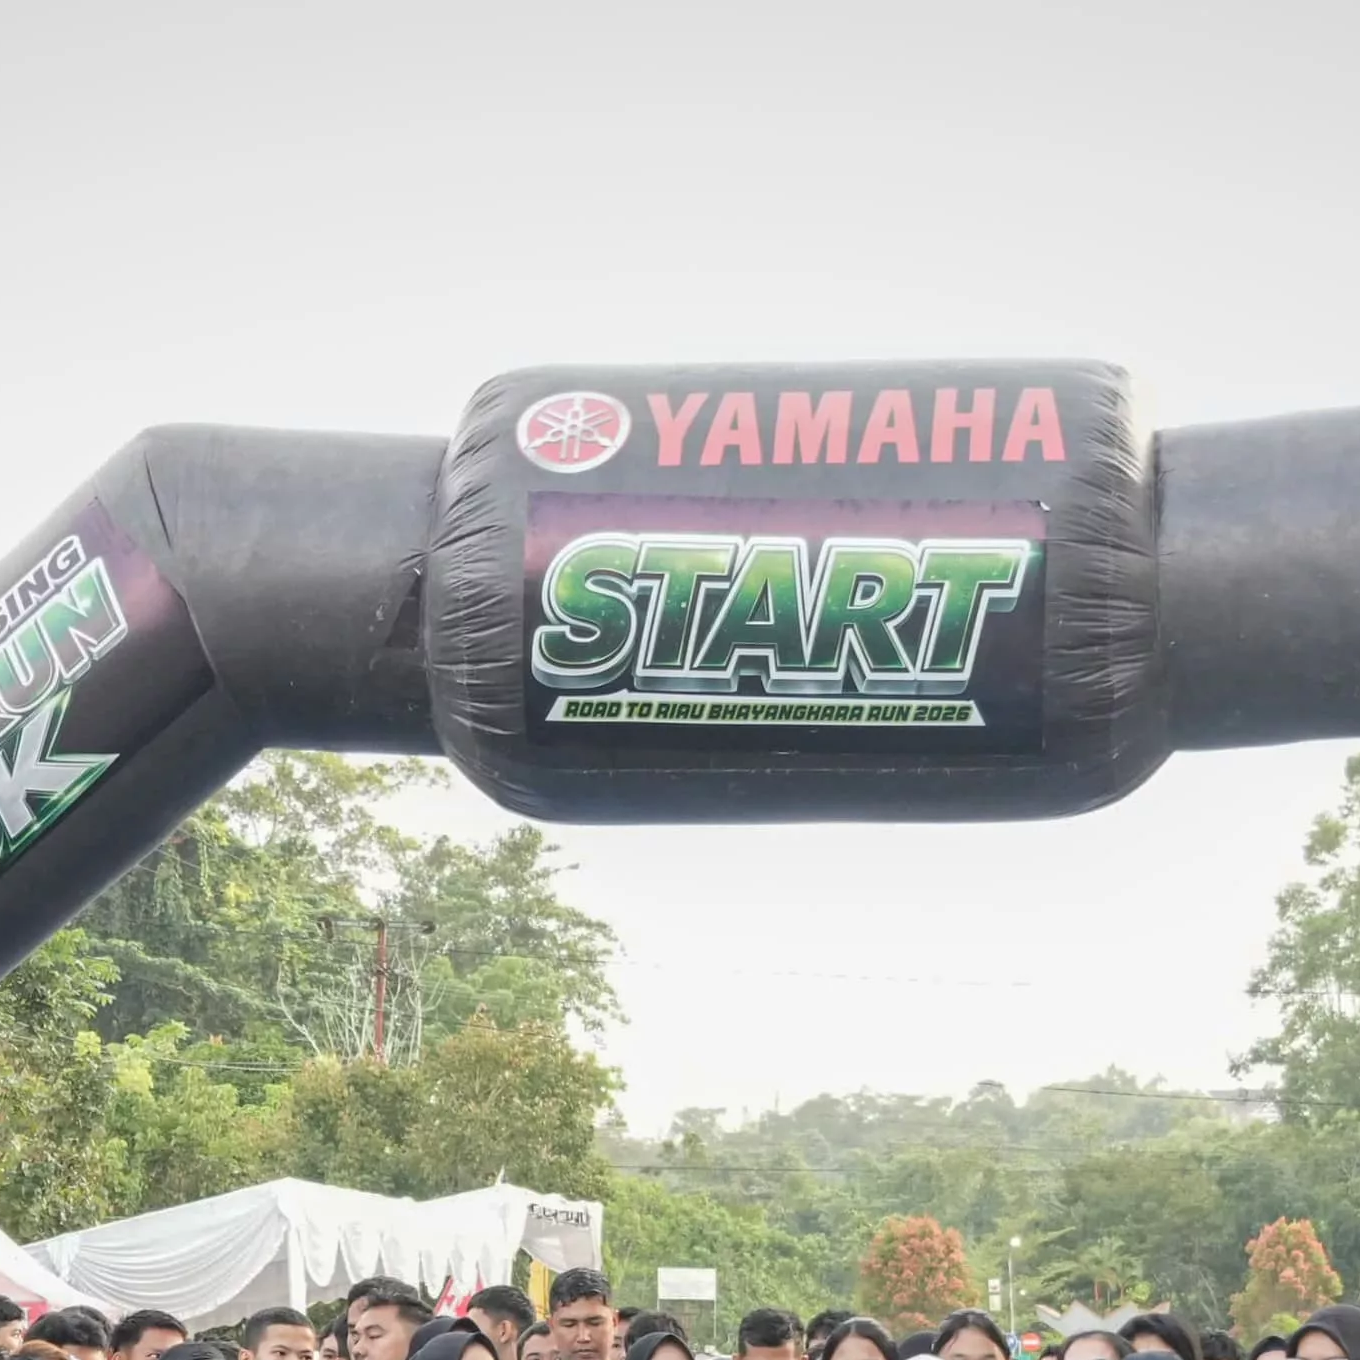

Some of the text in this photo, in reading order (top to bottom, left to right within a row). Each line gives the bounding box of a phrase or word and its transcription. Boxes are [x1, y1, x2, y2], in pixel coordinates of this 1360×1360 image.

[647, 388, 1065, 466] YAMAHA
[532, 533, 1033, 694] START
[563, 700, 622, 718] ROAD
[625, 701, 653, 718] TO
[654, 702, 705, 720] RIAU
[865, 705, 912, 722] RUN
[912, 705, 972, 722] 2026
